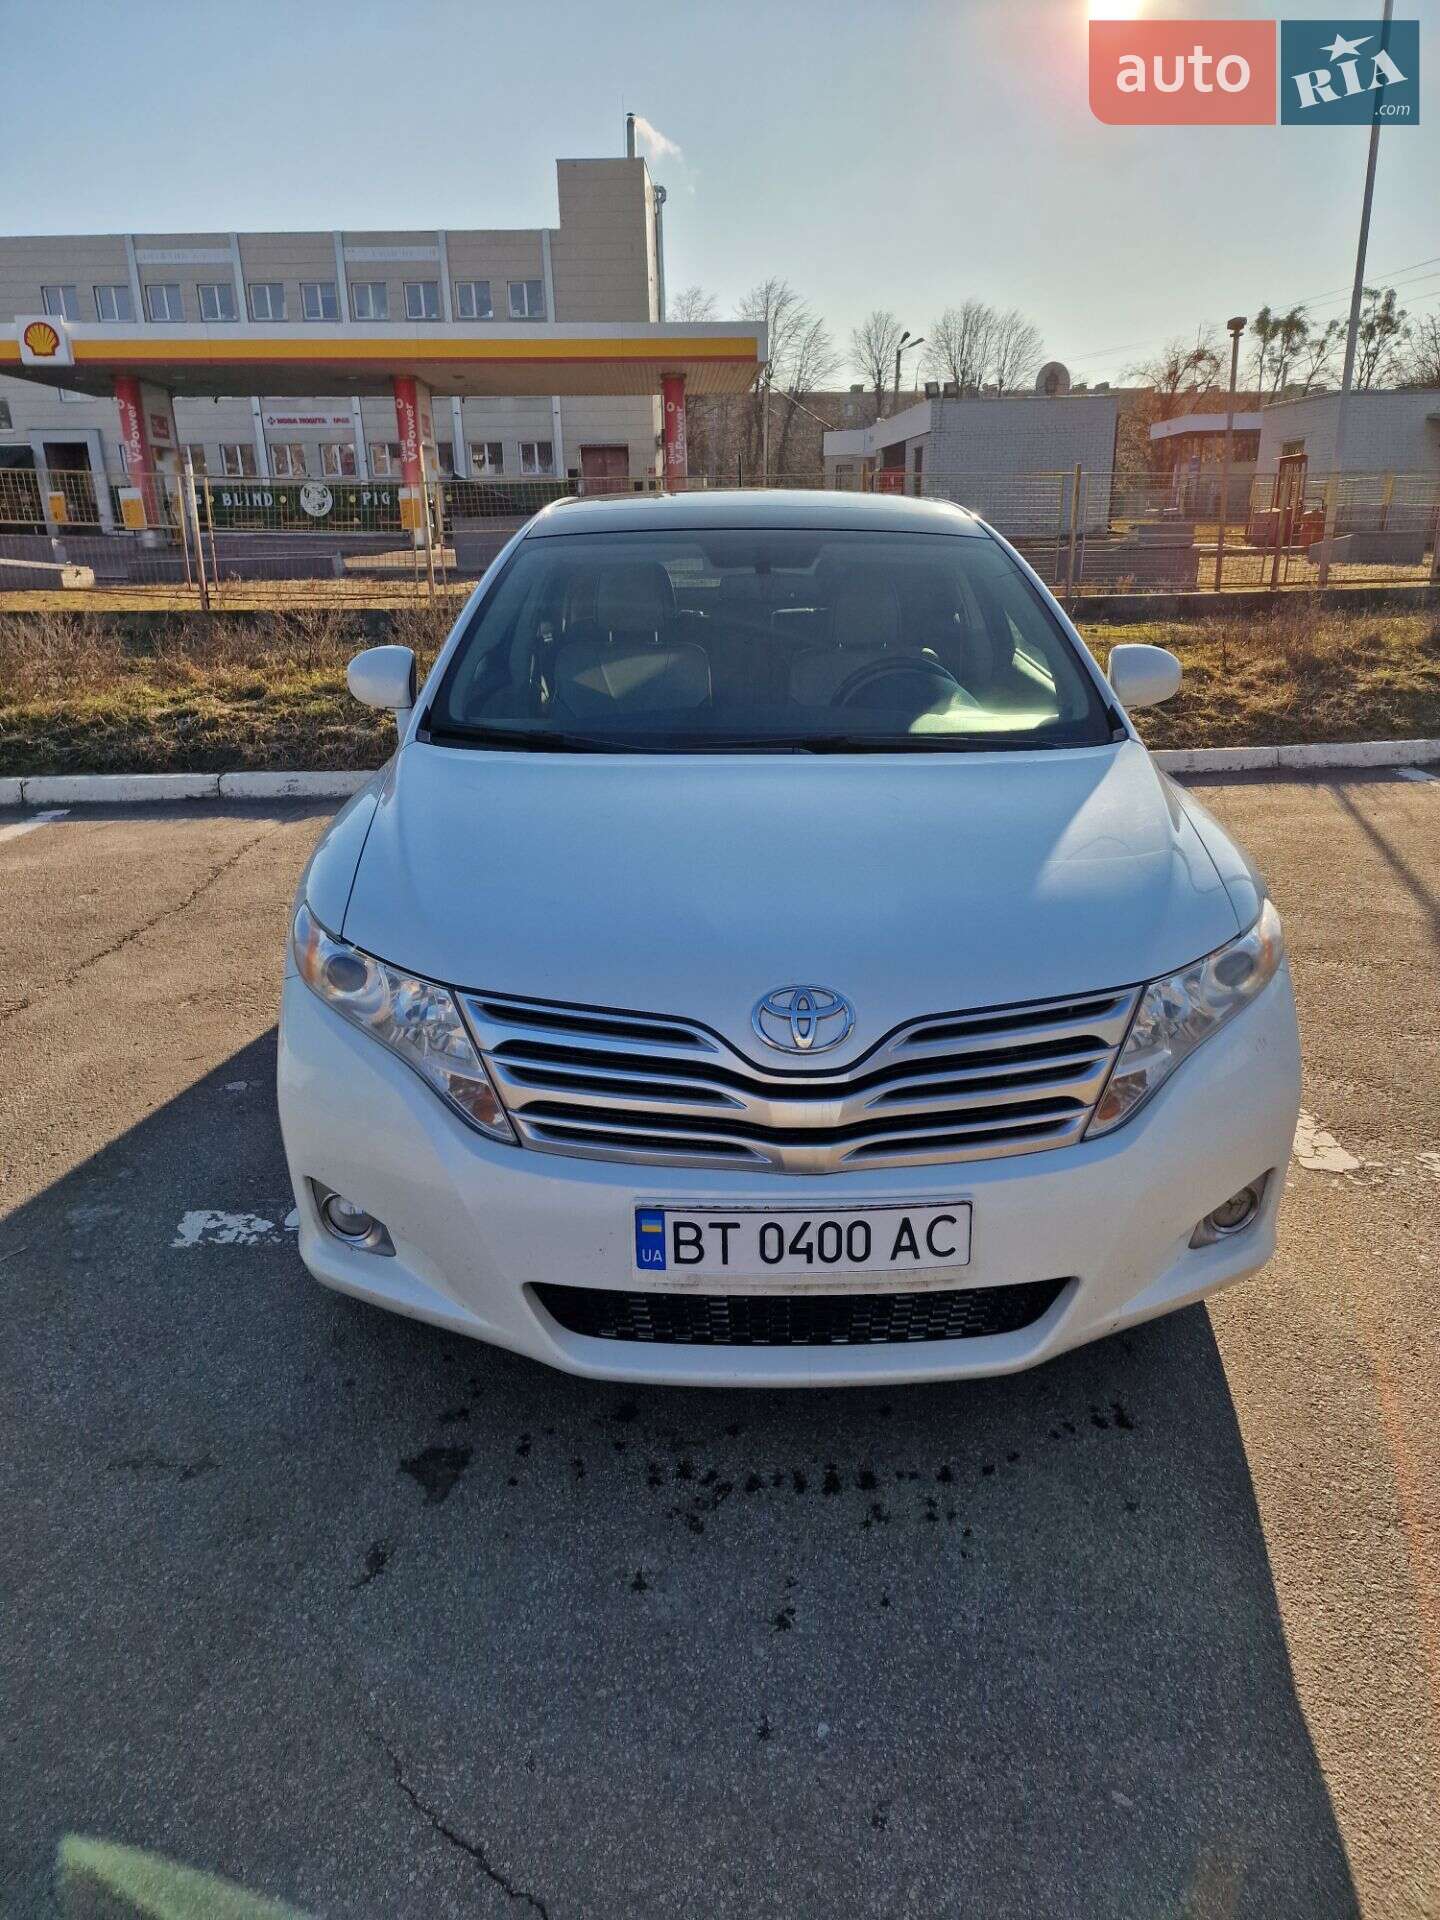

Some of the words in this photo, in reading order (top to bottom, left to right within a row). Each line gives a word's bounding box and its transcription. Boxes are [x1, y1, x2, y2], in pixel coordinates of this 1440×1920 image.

[127, 402, 143, 462] V-Power
[406, 402, 418, 463] V-Power
[675, 405, 685, 464] V-Power
[222, 492, 273, 506] BLIND
[361, 491, 390, 505] PIG
[642, 1248, 663, 1263] UA
[673, 1221, 741, 1265] BT
[758, 1220, 872, 1265] 0400
[889, 1214, 957, 1261] AC
